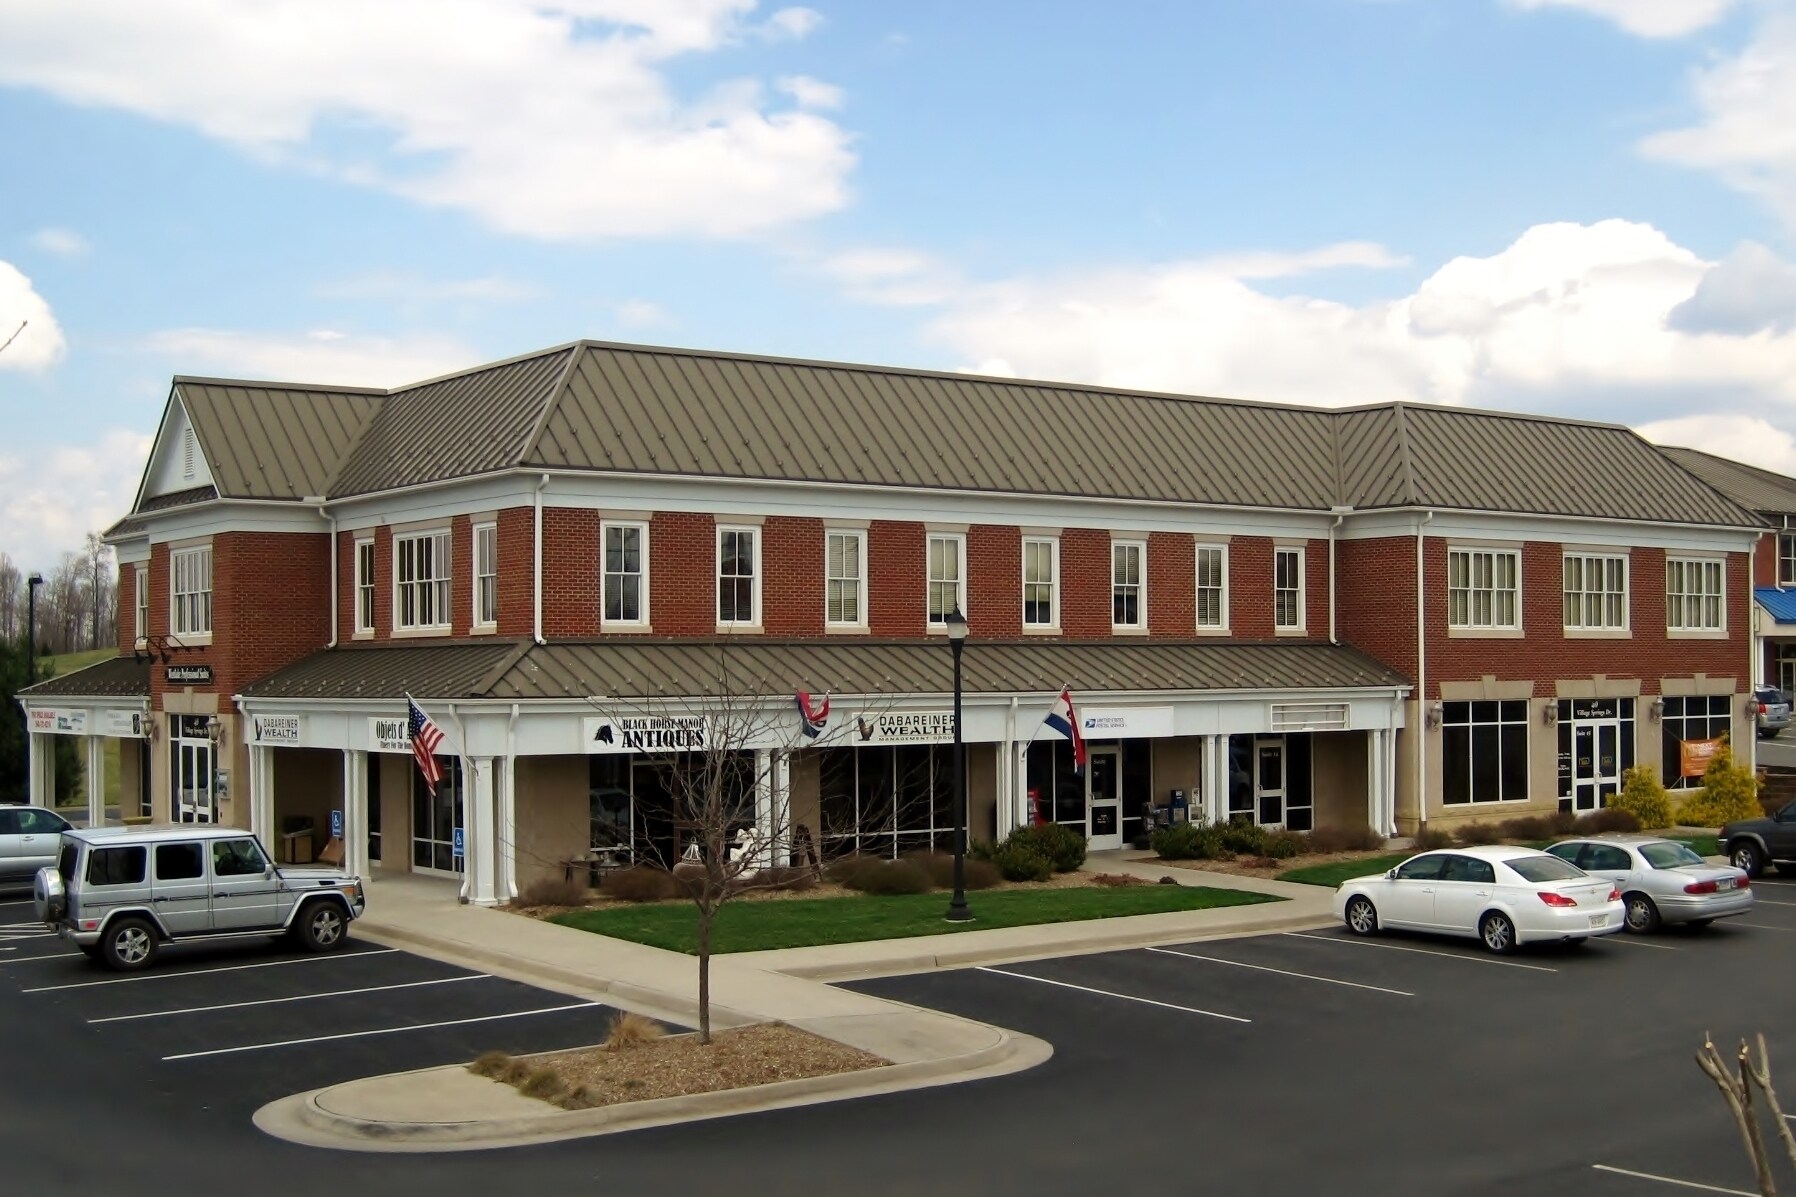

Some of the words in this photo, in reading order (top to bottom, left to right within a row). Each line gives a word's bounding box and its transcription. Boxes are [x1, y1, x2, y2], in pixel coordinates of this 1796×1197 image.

[263, 718, 298, 728] DABAREINER
[623, 718, 648, 730] BLACK
[650, 718, 676, 730] HORSE
[678, 717, 705, 729] MANOR
[879, 715, 955, 726] DABAREINER
[264, 728, 298, 738] WEALTH
[376, 720, 397, 741] Objets
[880, 726, 955, 736] WEALTH
[622, 729, 705, 748] ANTIQUES
